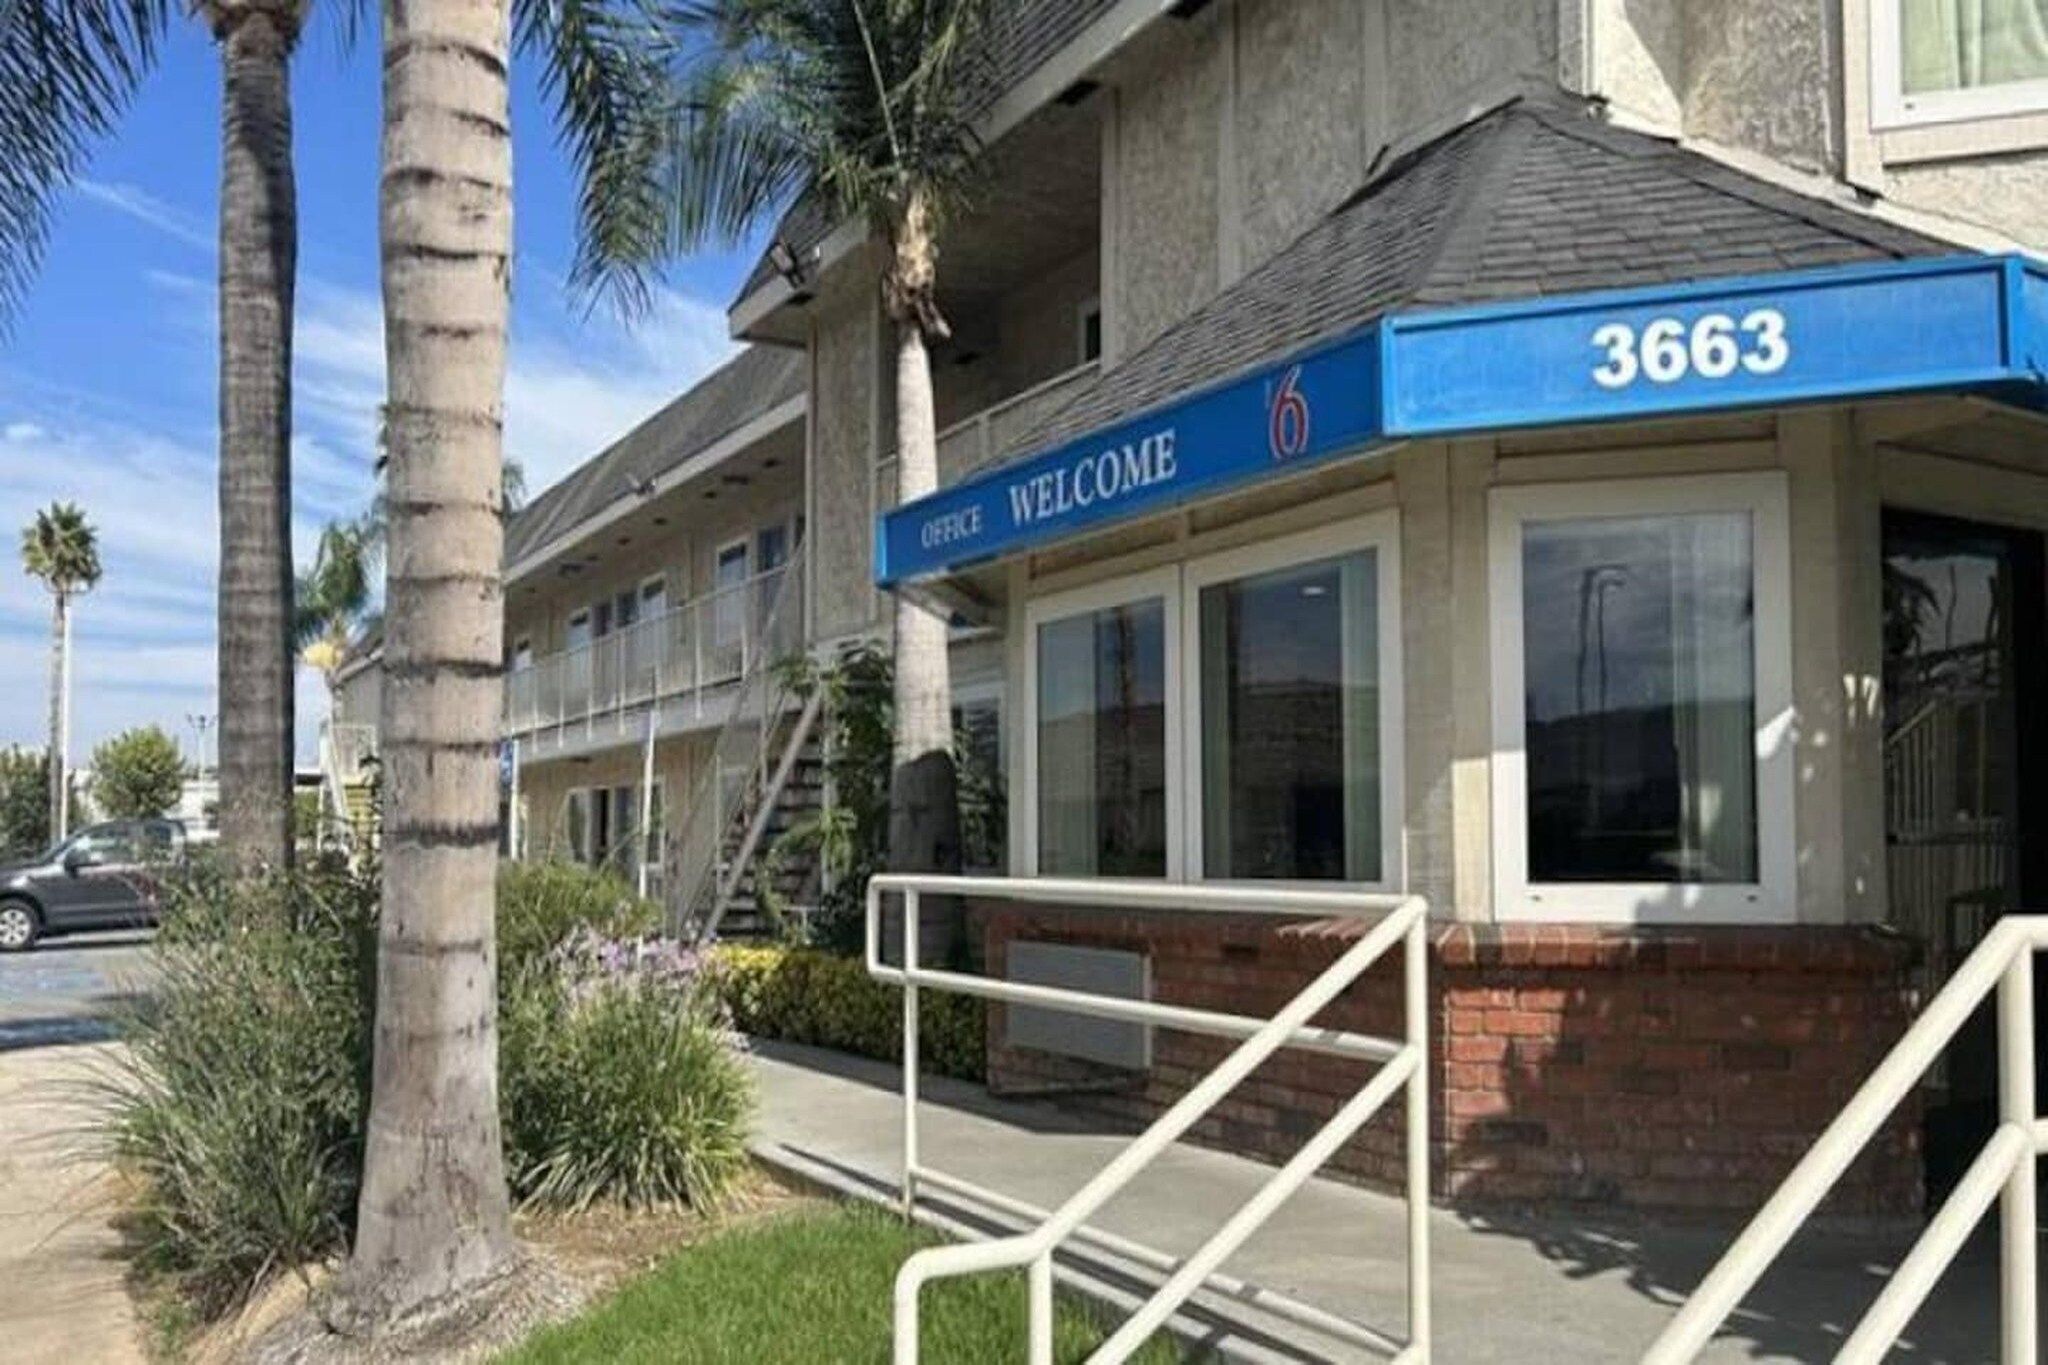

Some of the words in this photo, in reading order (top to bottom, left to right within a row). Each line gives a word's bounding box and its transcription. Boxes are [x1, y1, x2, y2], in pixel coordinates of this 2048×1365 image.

[1592, 308, 1789, 389] 3663
[921, 504, 982, 548] OFFICE
[1009, 428, 1177, 527] WELCOME
[1269, 363, 1309, 460] 6
